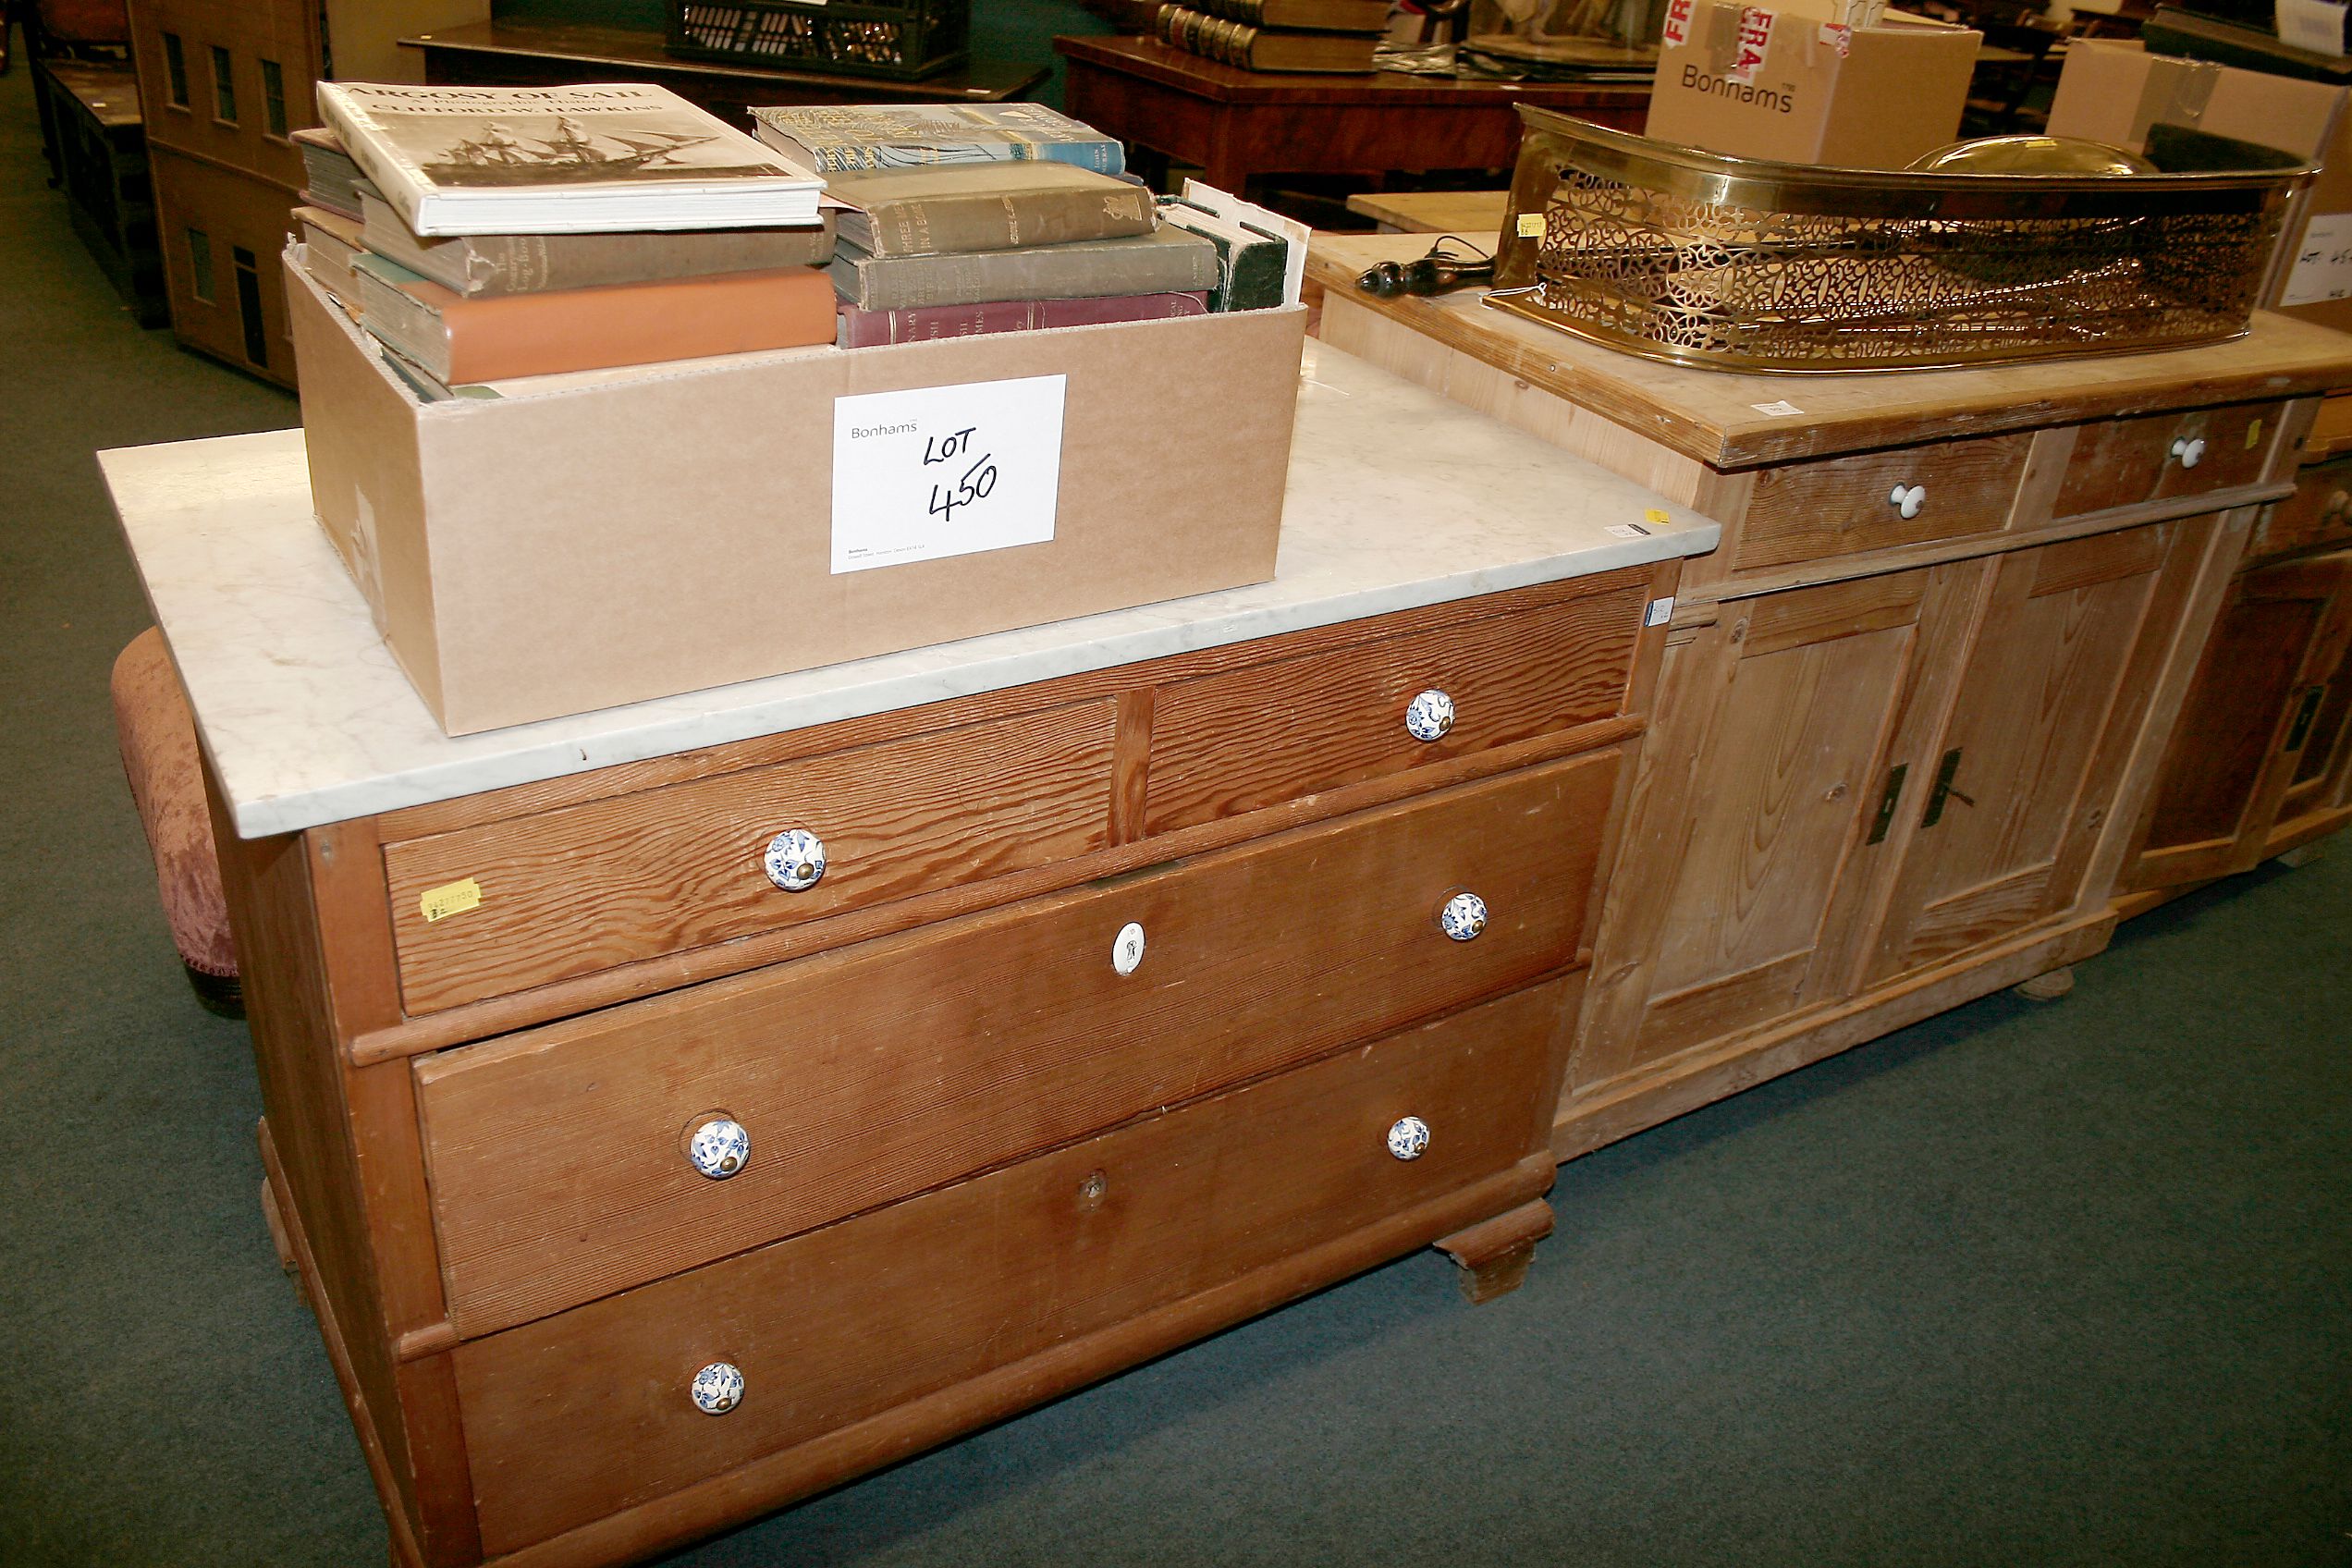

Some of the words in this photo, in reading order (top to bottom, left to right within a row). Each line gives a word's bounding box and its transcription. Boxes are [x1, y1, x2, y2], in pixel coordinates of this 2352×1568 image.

[1664, 0, 1691, 43] FR
[349, 88, 496, 100] ARGOSY
[569, 91, 652, 99] SAIL
[1682, 64, 1793, 114] Bonhams
[372, 104, 507, 114] CLIFFORD
[545, 104, 664, 114] HAWKINS
[899, 220, 914, 253] THREE
[920, 237, 932, 250] IN
[851, 420, 918, 439] Bonhams
[924, 426, 976, 466] LOT
[929, 453, 998, 522] 450
